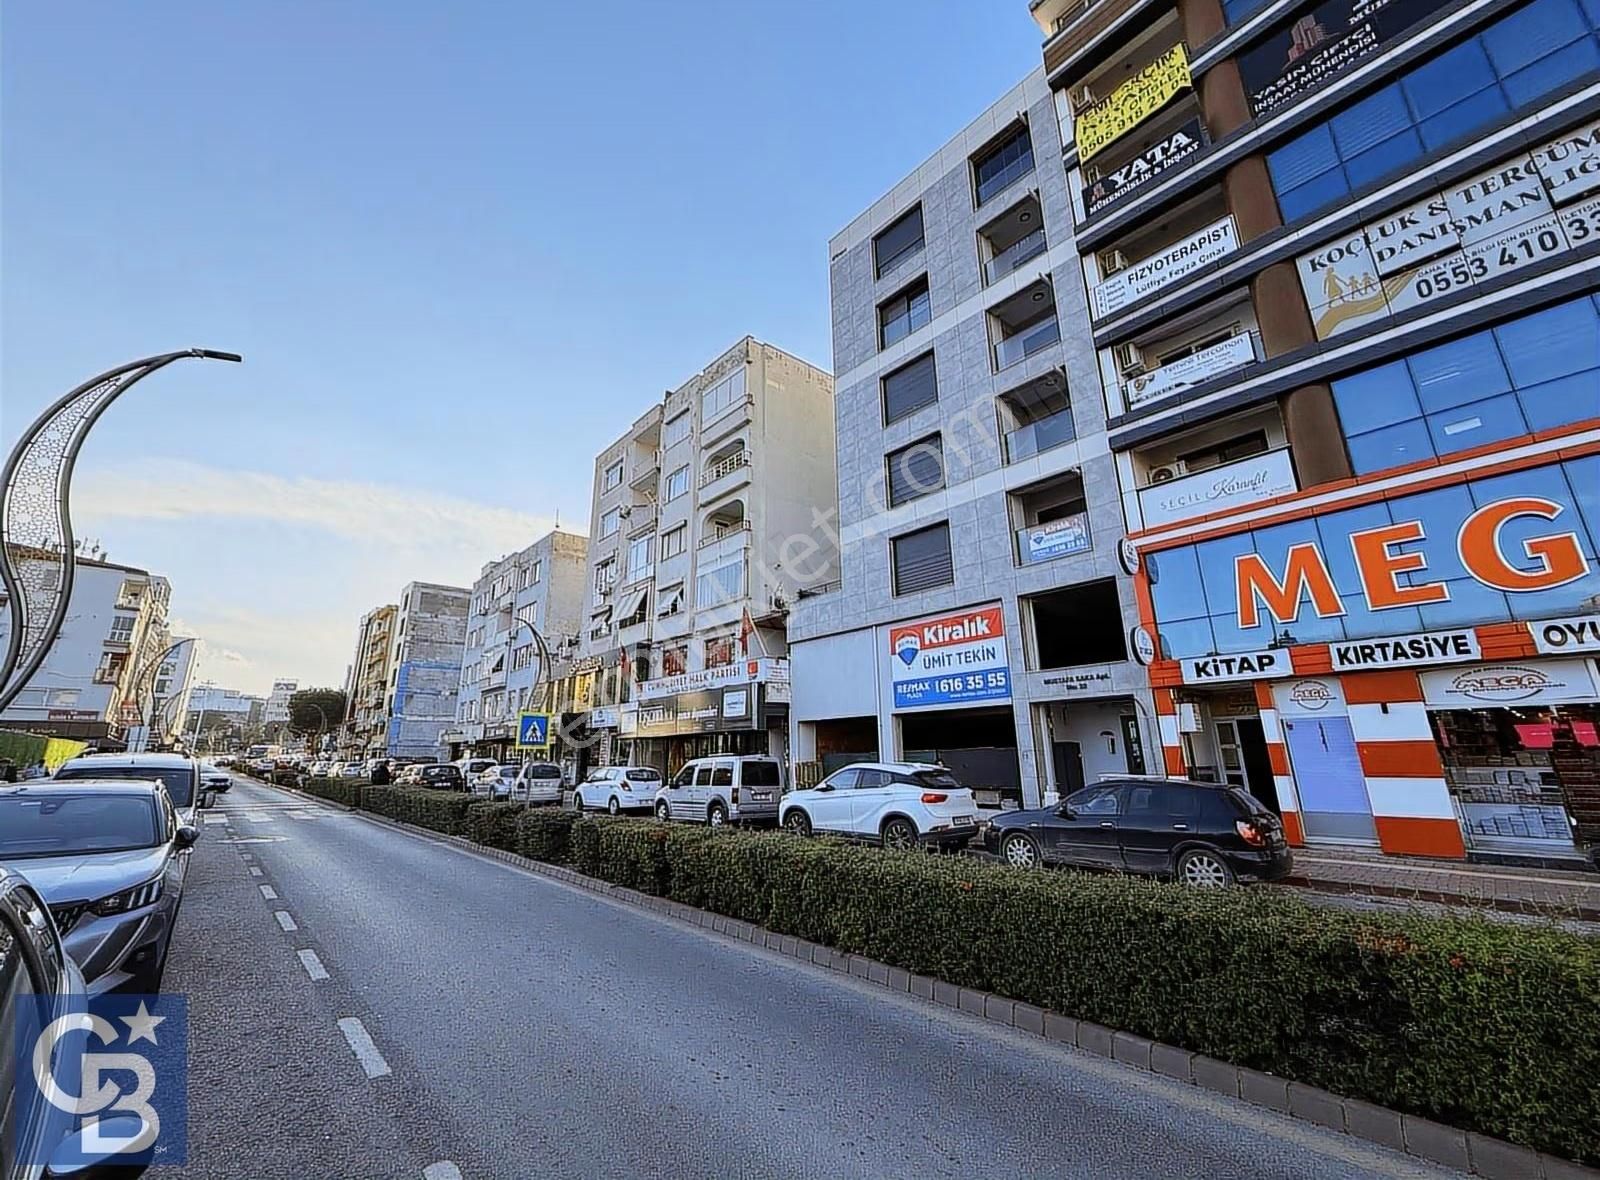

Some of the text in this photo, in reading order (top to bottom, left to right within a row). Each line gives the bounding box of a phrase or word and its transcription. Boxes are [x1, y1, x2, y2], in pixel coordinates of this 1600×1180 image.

[1081, 130, 1113, 158] 0505
[1147, 90, 1165, 109] 21
[1108, 131, 1193, 189] YATA
[1127, 223, 1230, 285] FİZYOTERAPİST
[1308, 211, 1420, 273] KOÇLUK
[1427, 201, 1448, 217] &
[1136, 272, 1167, 295] Lütfiye
[1169, 260, 1197, 279] Feyza
[1198, 245, 1227, 264] Çınar
[1416, 257, 1488, 299] 0553
[1499, 229, 1559, 266] 410
[923, 616, 991, 645] Kiralık
[923, 645, 997, 670] ÜMİT TEKİN
[966, 675, 984, 690] 35
[987, 671, 1006, 687] 55
[1195, 654, 1275, 678] KİTAP
[1336, 634, 1472, 666] KIRTASİYE
[1455, 673, 1546, 690] MEGA
